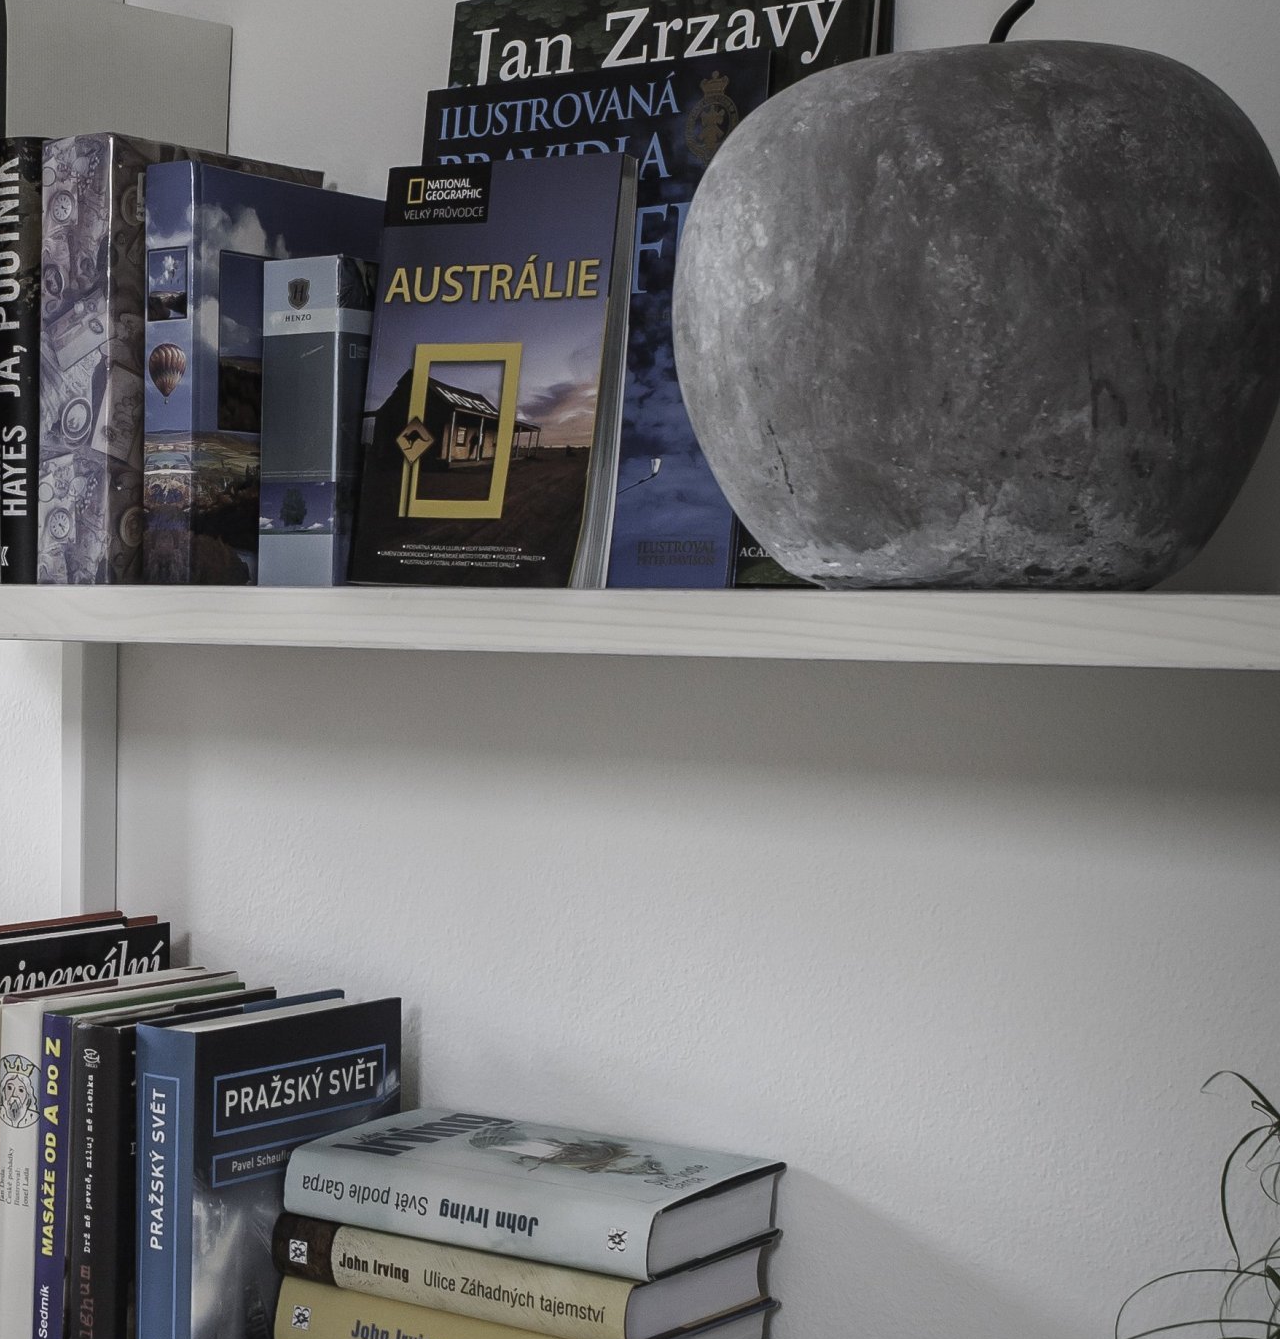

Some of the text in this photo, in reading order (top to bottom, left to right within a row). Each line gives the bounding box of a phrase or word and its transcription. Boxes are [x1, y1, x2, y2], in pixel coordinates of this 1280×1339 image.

[472, 27, 574, 86] Jan
[437, 71, 682, 141] ILUSTROVANÁ
[425, 188, 483, 202] GEOGRAPHIC
[427, 177, 472, 190] NATIONAL
[404, 206, 485, 221] VELKÝ PRŮVODCE
[383, 252, 602, 306] AUSTRÁLIE
[285, 313, 312, 323] HENZO
[2, 424, 28, 516] HAYES
[85, 1073, 94, 1114] zlehka
[225, 1057, 378, 1118] PRAŽSKÝ SVĚT
[85, 1118, 93, 1132] mě
[331, 1113, 514, 1157] Irving
[39, 1037, 61, 1256] MASÁŽE OD A DO Z
[84, 1137, 94, 1169] miluj
[231, 1156, 255, 1173] Pavel
[5, 1147, 15, 1205] České pohádky
[13, 1167, 21, 1206] Ilustroval:
[21, 1167, 30, 1207] Josef Lada
[148, 1087, 166, 1250] PRAŽSKÝ SVĚT
[83, 1173, 94, 1210] pevně,
[302, 1173, 539, 1239] John Irving Svět podle Garpa
[83, 1214, 92, 1228] mě
[82, 1233, 92, 1254] Drž
[338, 1252, 606, 1324] John Irving Ulice Záhadných tajemství
[38, 1284, 50, 1339] Sedmík
